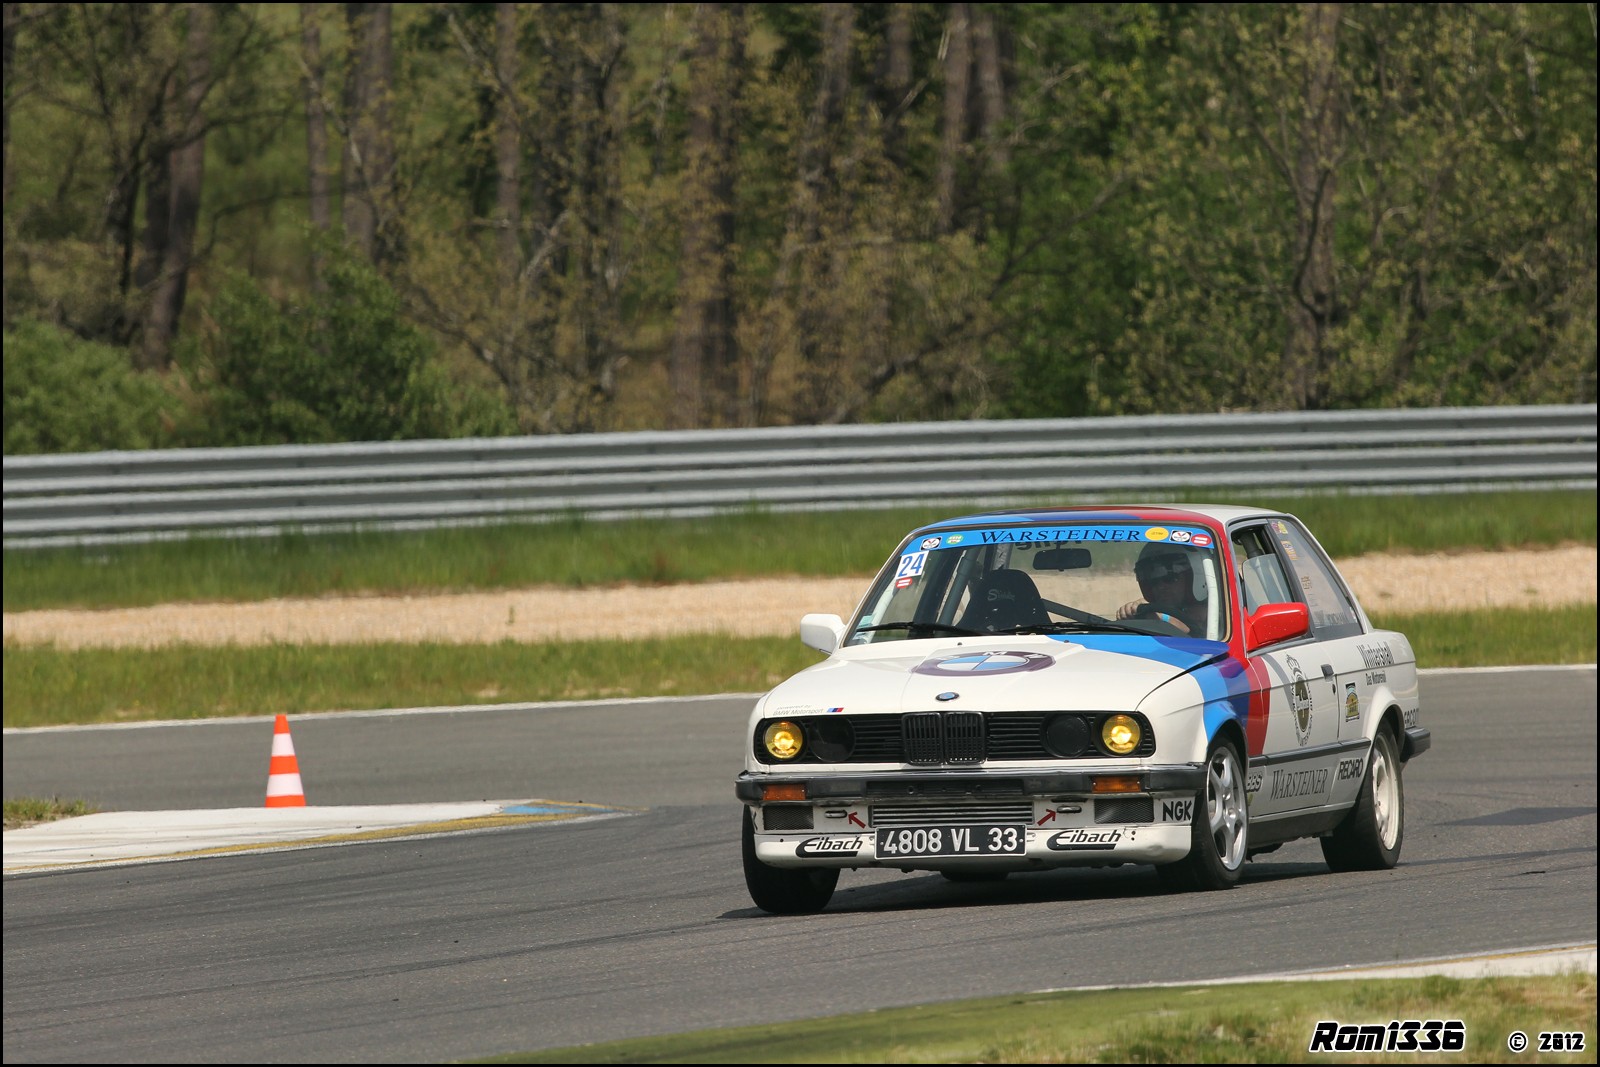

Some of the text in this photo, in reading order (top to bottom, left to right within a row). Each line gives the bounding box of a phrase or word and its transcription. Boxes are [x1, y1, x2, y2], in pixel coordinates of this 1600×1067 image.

[980, 529, 1140, 543] WARSTEINER
[898, 553, 925, 577] 24
[1337, 758, 1364, 780] RECARO
[1246, 773, 1263, 792] BBS
[1270, 768, 1328, 801] WARSTEINER
[1162, 800, 1192, 821] NGK
[796, 837, 863, 858] Eibach
[883, 828, 1018, 854] 4808 VL 33
[1047, 829, 1121, 851] Eibach
